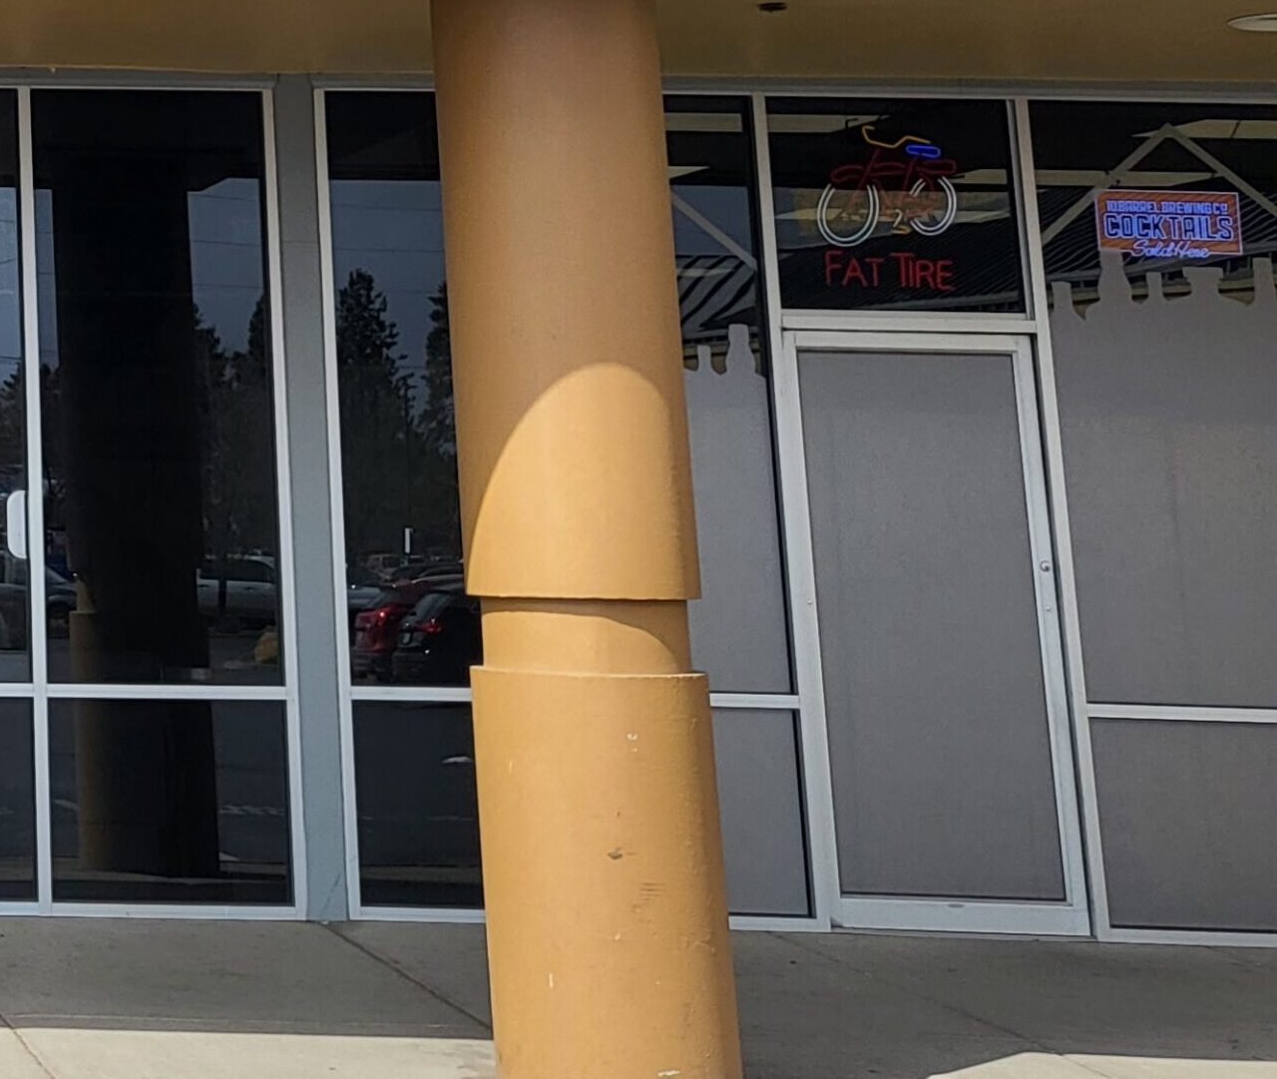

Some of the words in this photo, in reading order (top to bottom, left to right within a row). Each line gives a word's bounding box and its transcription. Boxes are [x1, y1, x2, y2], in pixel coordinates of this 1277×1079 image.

[1103, 213, 1235, 242] COCKTAILS
[824, 249, 884, 288] FAT
[890, 251, 956, 291] TIRE
